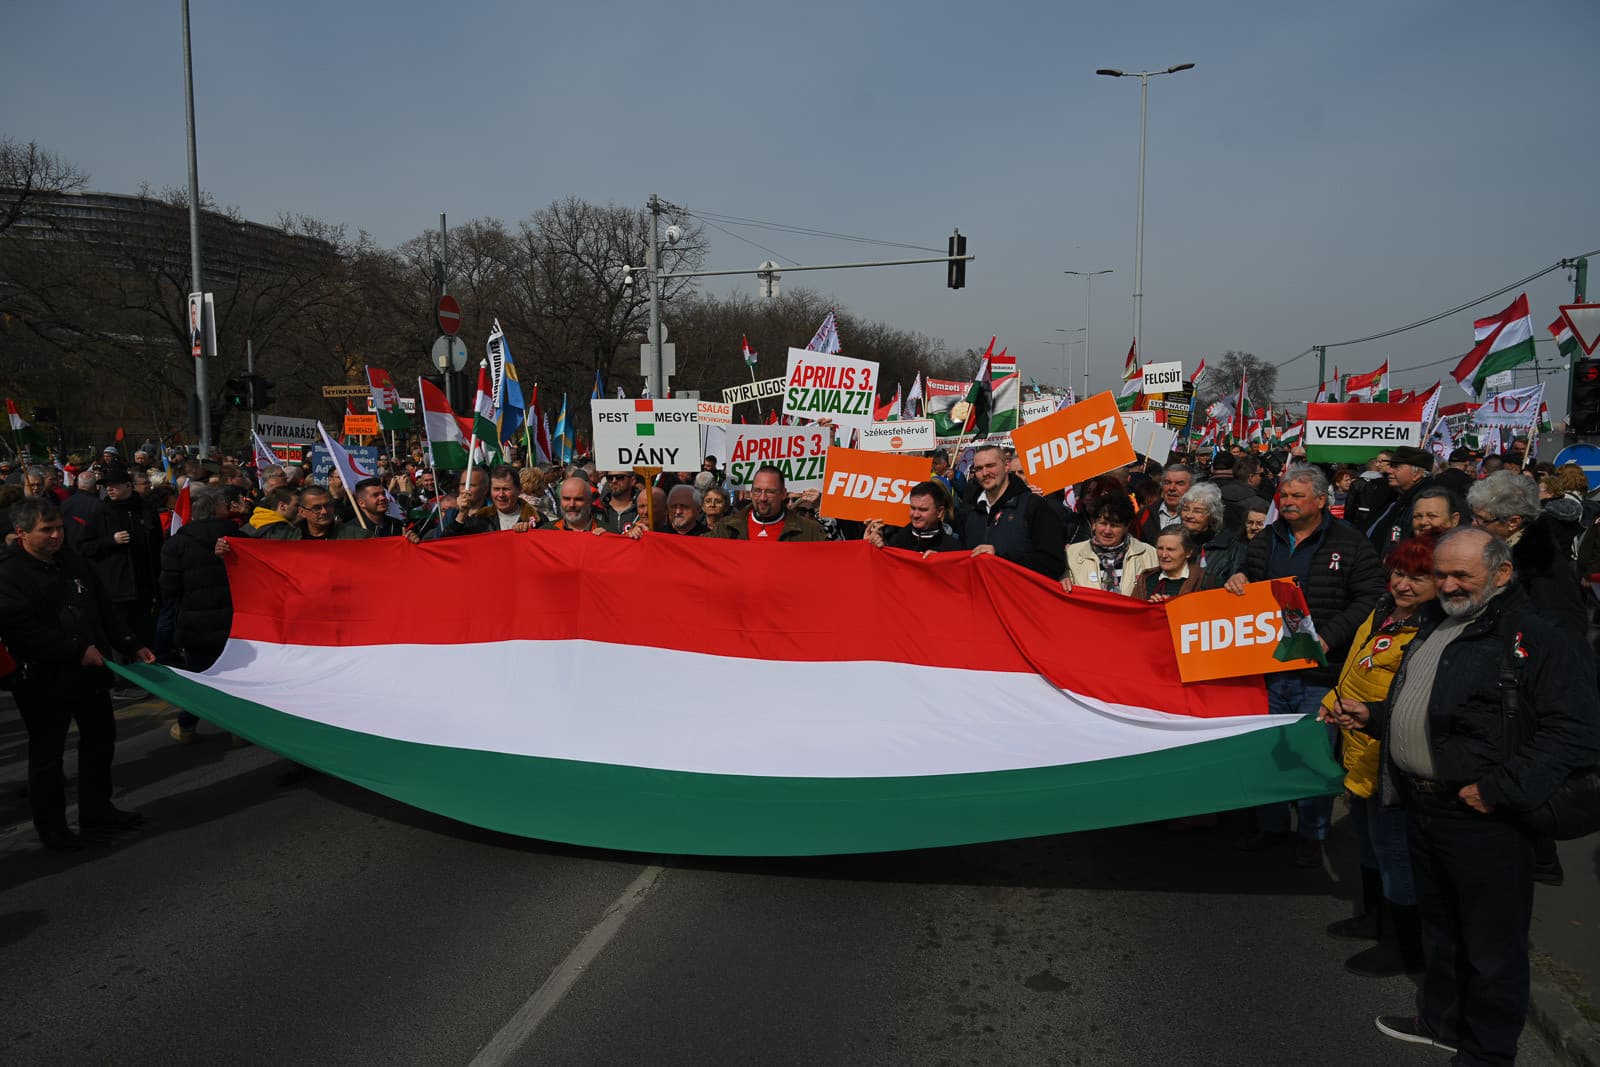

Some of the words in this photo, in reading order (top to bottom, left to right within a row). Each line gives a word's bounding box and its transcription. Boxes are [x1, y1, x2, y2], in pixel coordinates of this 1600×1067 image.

[789, 361, 855, 390] ÁPRILIS
[858, 368, 873, 390] 3.
[1144, 369, 1181, 385] FELCSÚT
[786, 387, 873, 416] SZAVAZZ!
[599, 413, 629, 423] PEST
[655, 412, 697, 423] MEGYE
[258, 421, 316, 440] NYÍRKARÁSZ
[1315, 424, 1410, 441] VESZPRÉM
[618, 443, 679, 465] DÁNY
[731, 434, 805, 462] ÁPRILIS
[810, 434, 826, 456] 3.
[1025, 416, 1119, 476] FIDESZ
